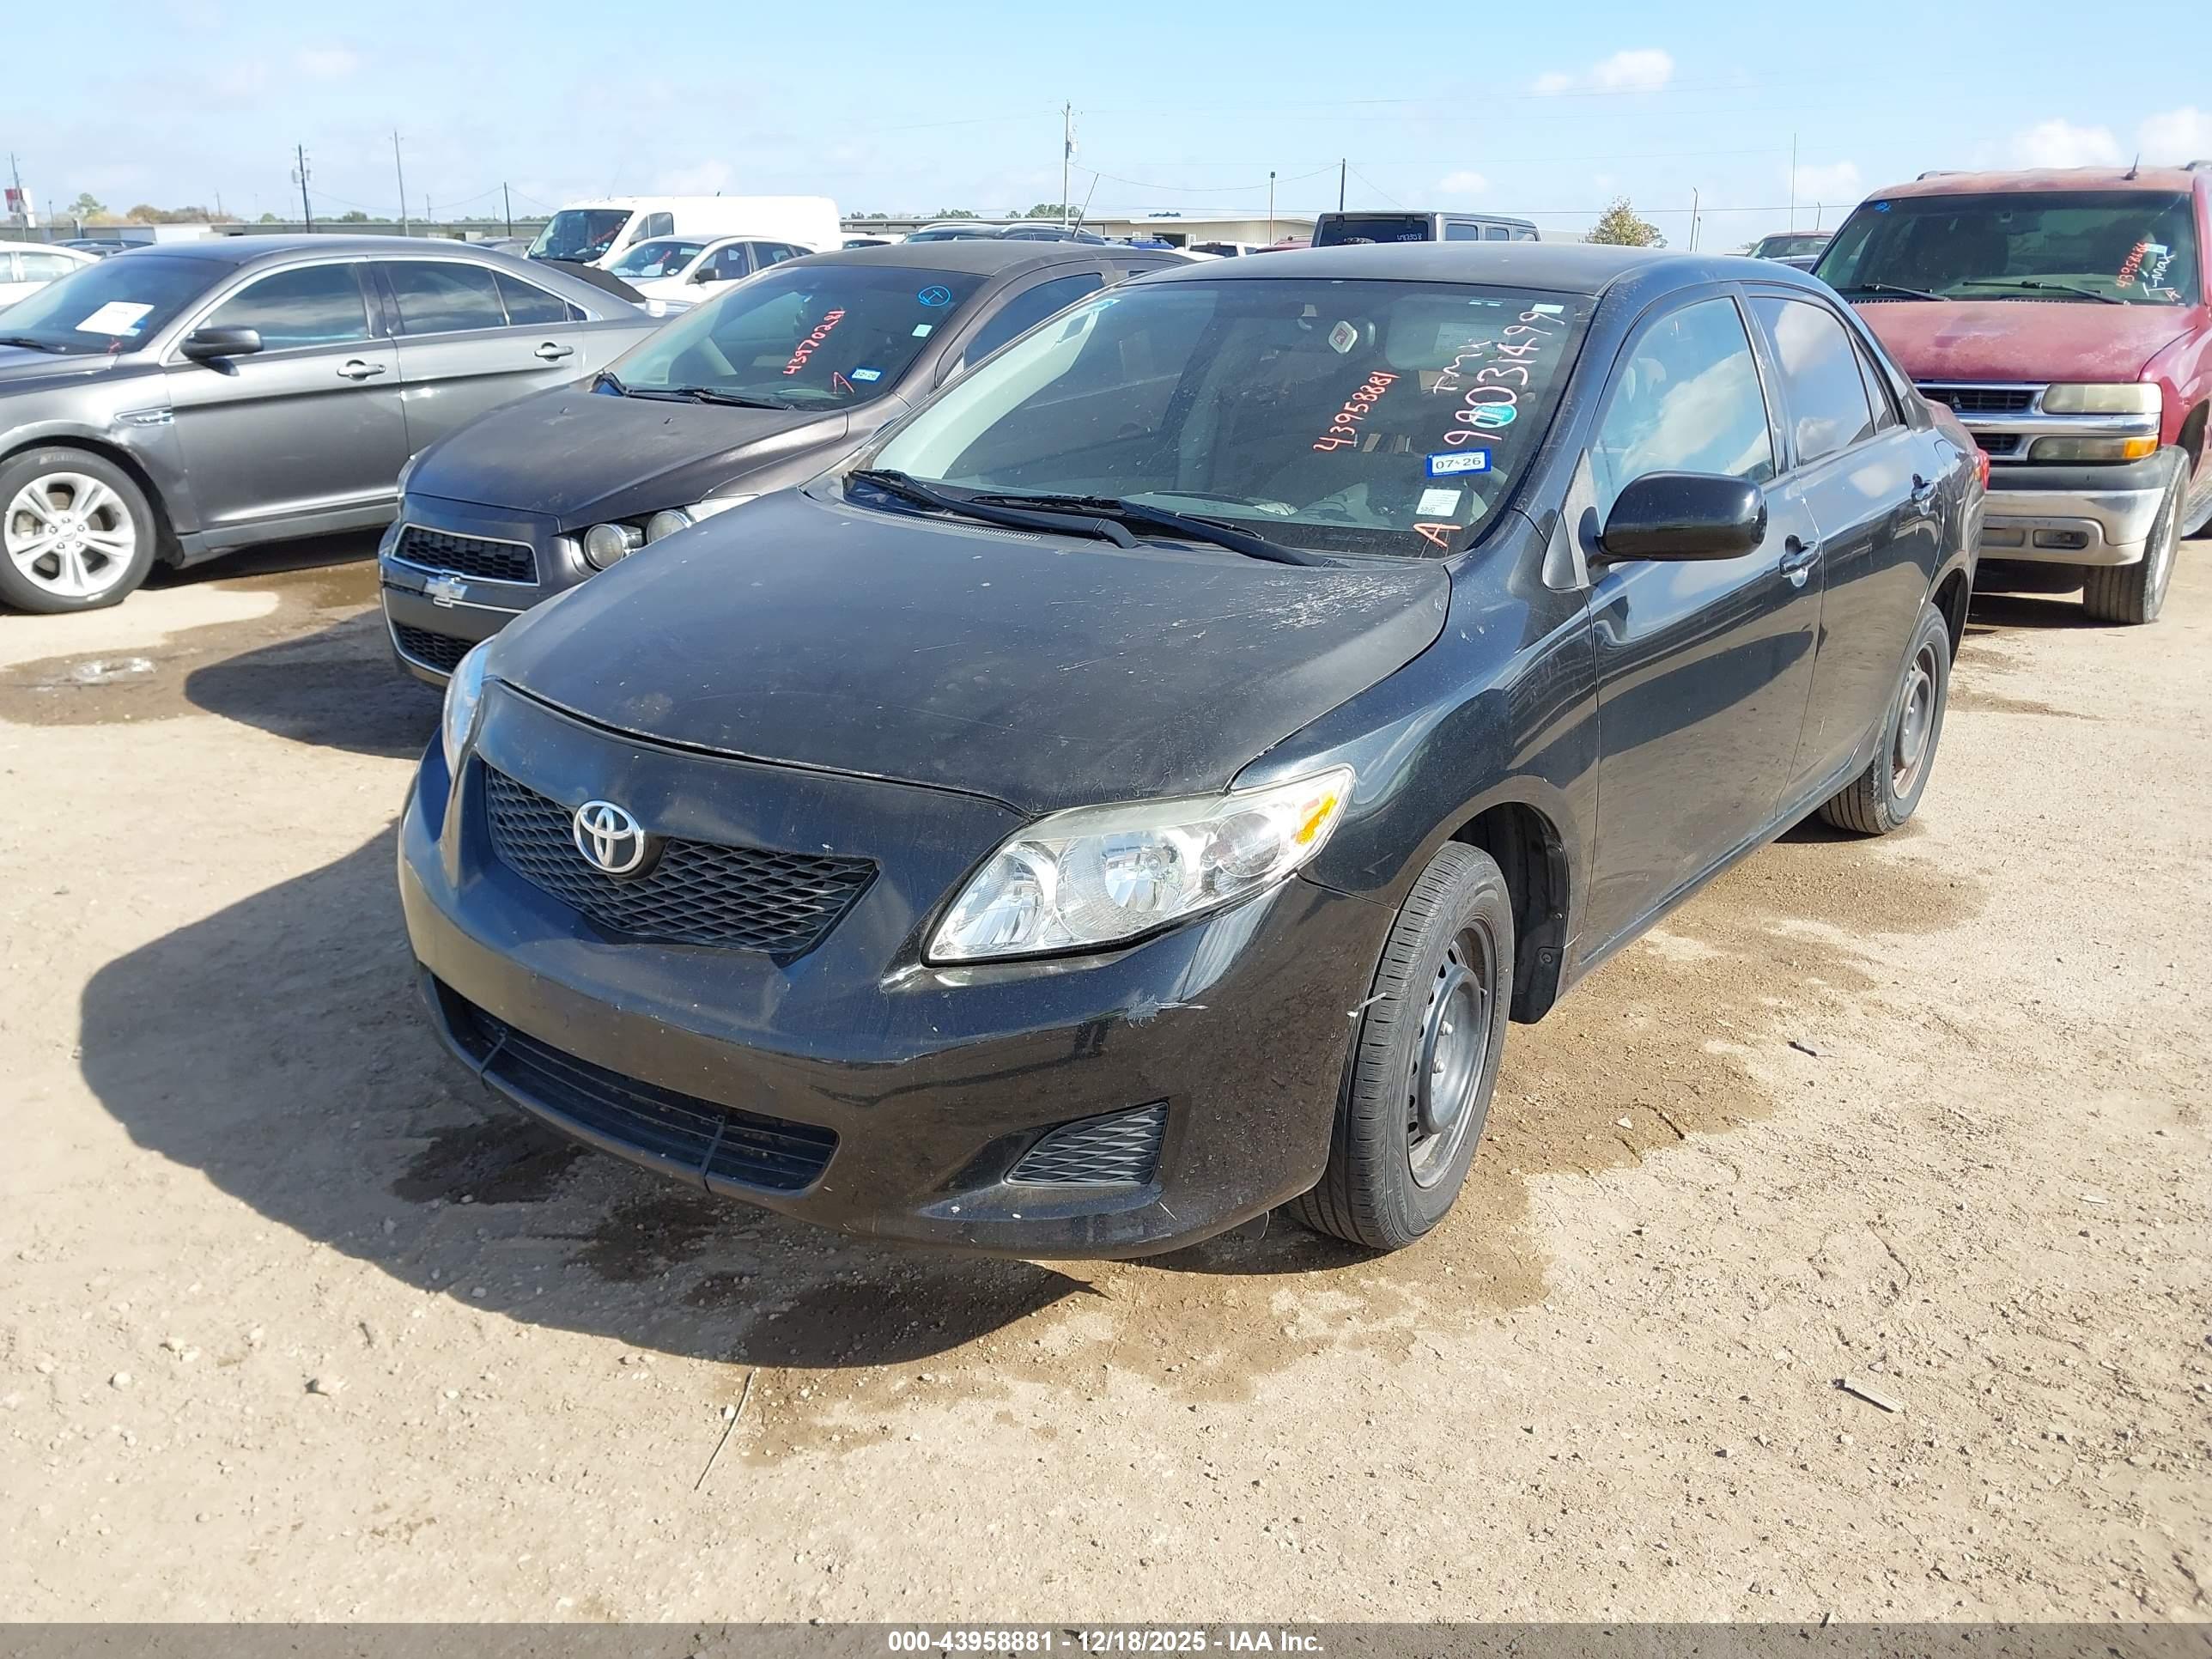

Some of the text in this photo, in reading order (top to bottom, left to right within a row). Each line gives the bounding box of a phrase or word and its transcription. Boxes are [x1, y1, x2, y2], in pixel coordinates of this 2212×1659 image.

[783, 310, 846, 374] 43970281
[1313, 371, 1401, 451] 43958881
[1413, 522, 1462, 548] A
